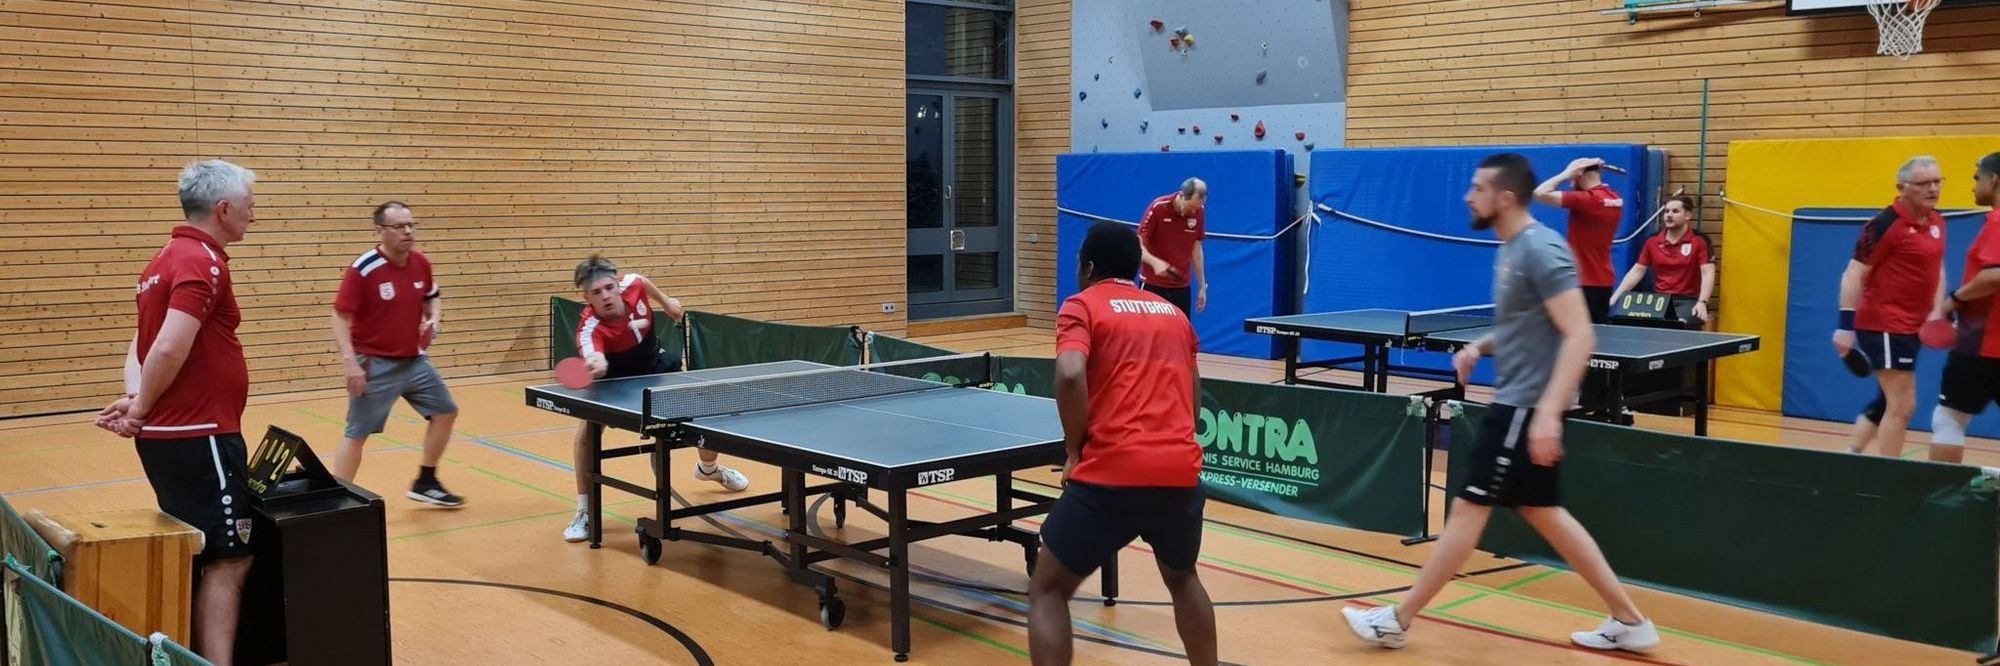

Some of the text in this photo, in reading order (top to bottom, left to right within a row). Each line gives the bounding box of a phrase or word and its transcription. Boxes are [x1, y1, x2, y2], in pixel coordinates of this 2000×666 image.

[1622, 294, 1632, 309] 0
[1655, 296, 1664, 311] 0
[1599, 359, 1620, 370] TSP
[1194, 407, 1318, 465] ONTRA
[270, 448, 290, 481] 2
[847, 467, 868, 484] TSP
[928, 468, 955, 482] TSP
[1202, 452, 1319, 480] NIS SERVICE HAMBURG
[1199, 470, 1299, 497] XPRESS-VERSENDER
